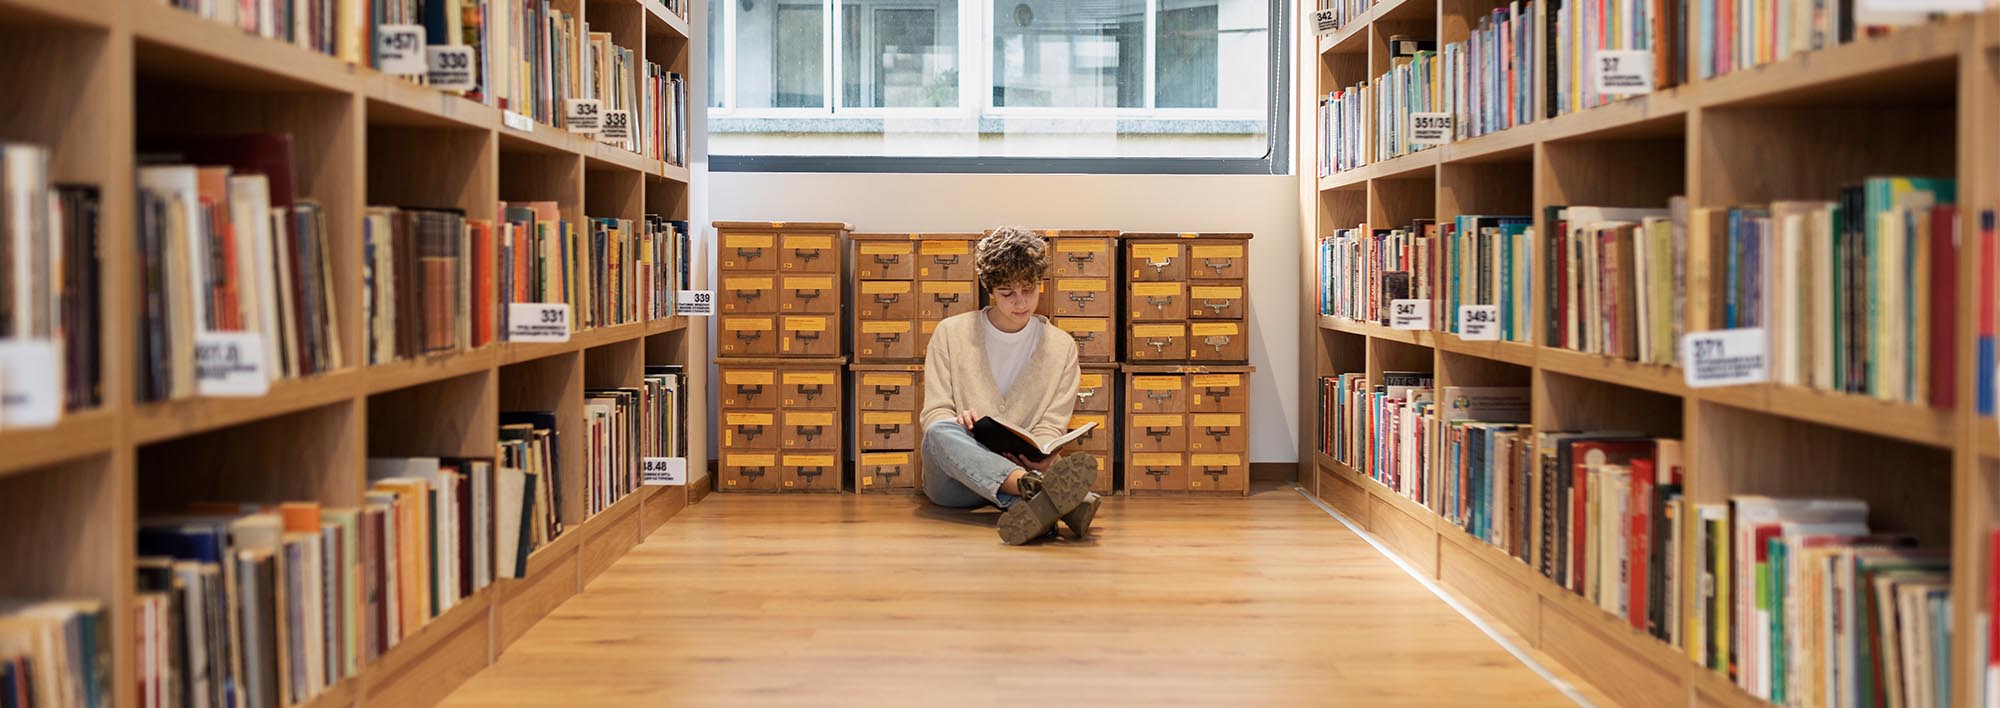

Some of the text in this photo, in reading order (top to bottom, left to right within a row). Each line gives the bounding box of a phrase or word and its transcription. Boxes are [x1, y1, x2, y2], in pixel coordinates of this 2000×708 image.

[1316, 10, 1333, 21] 342
[439, 52, 468, 68] 330
[576, 103, 598, 115] 334
[605, 112, 627, 126] 338
[694, 293, 711, 303] 339
[1396, 303, 1416, 315] 347
[541, 309, 564, 323] 331
